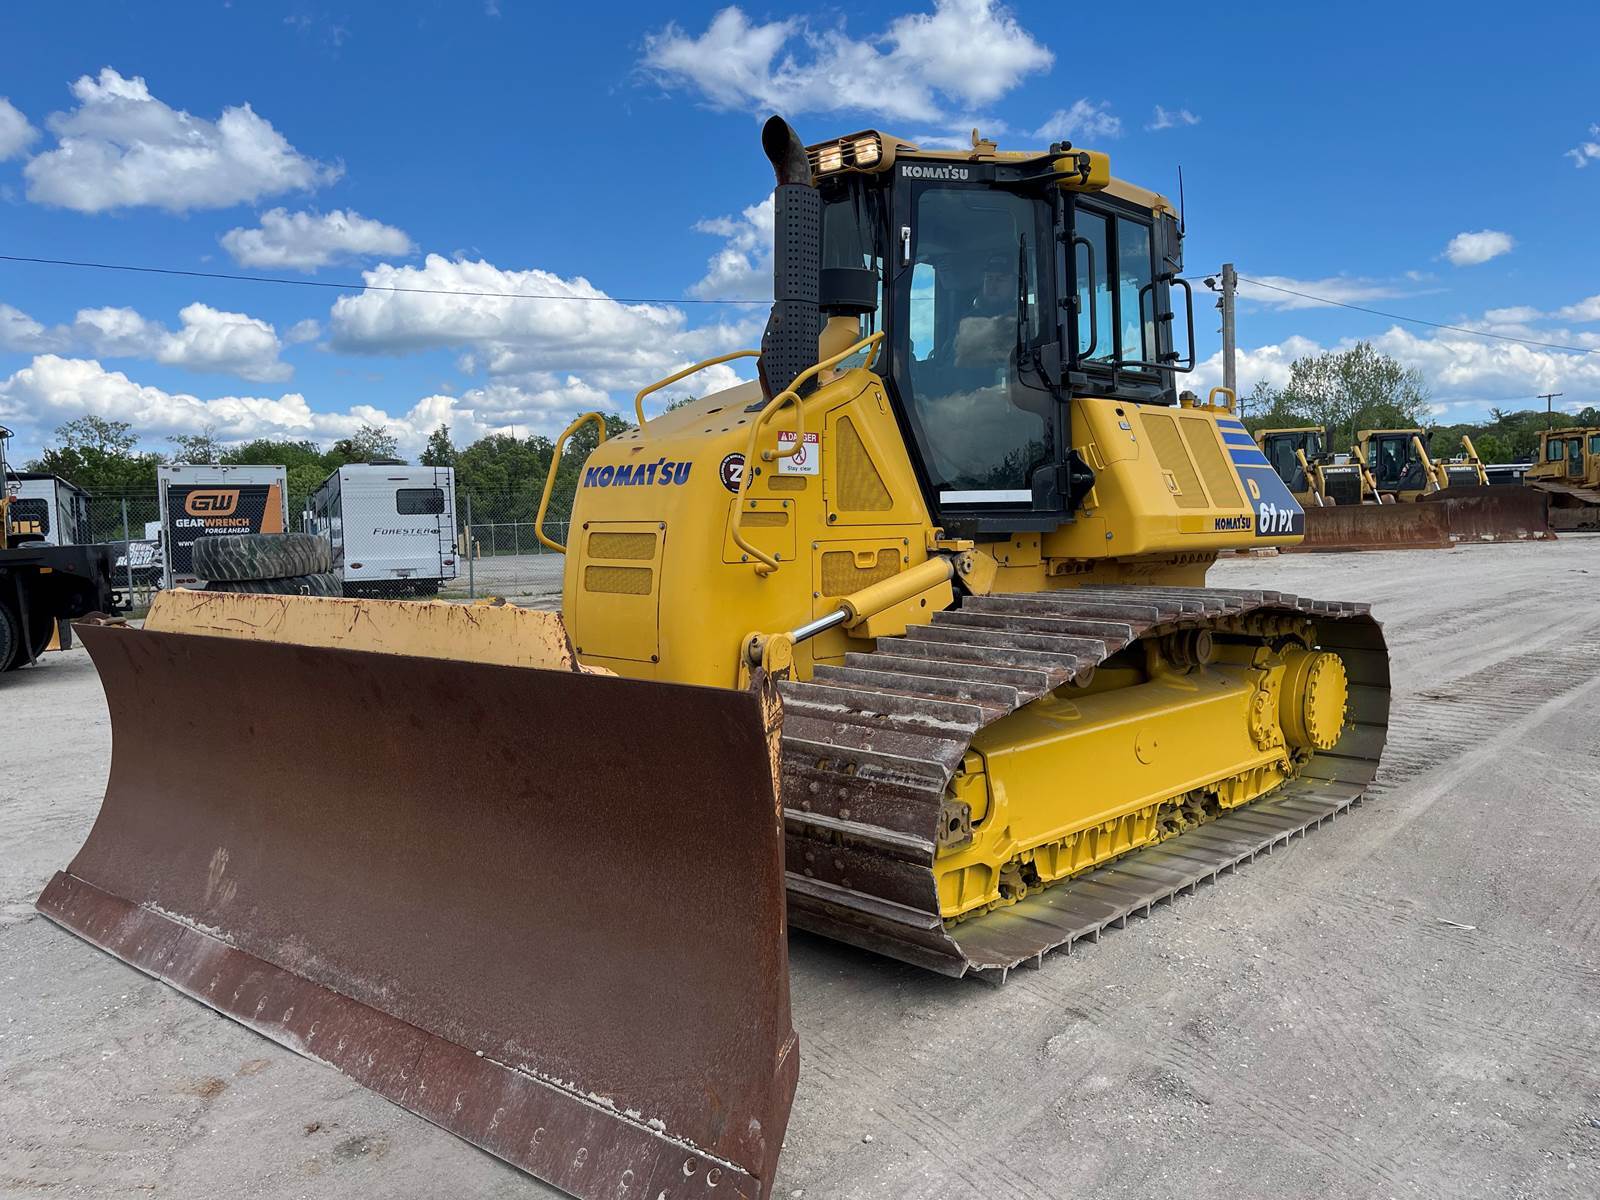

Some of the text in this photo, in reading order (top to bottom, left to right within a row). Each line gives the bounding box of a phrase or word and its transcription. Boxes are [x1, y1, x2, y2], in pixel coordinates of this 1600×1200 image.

[902, 165, 969, 180] KOMATSU
[788, 432, 817, 442] DAGER
[583, 457, 693, 487] KOMATSU
[729, 464, 744, 482] Z
[1247, 478, 1260, 500] D
[176, 518, 250, 528] GEARWRENCH
[1215, 514, 1251, 530] KOMATSU
